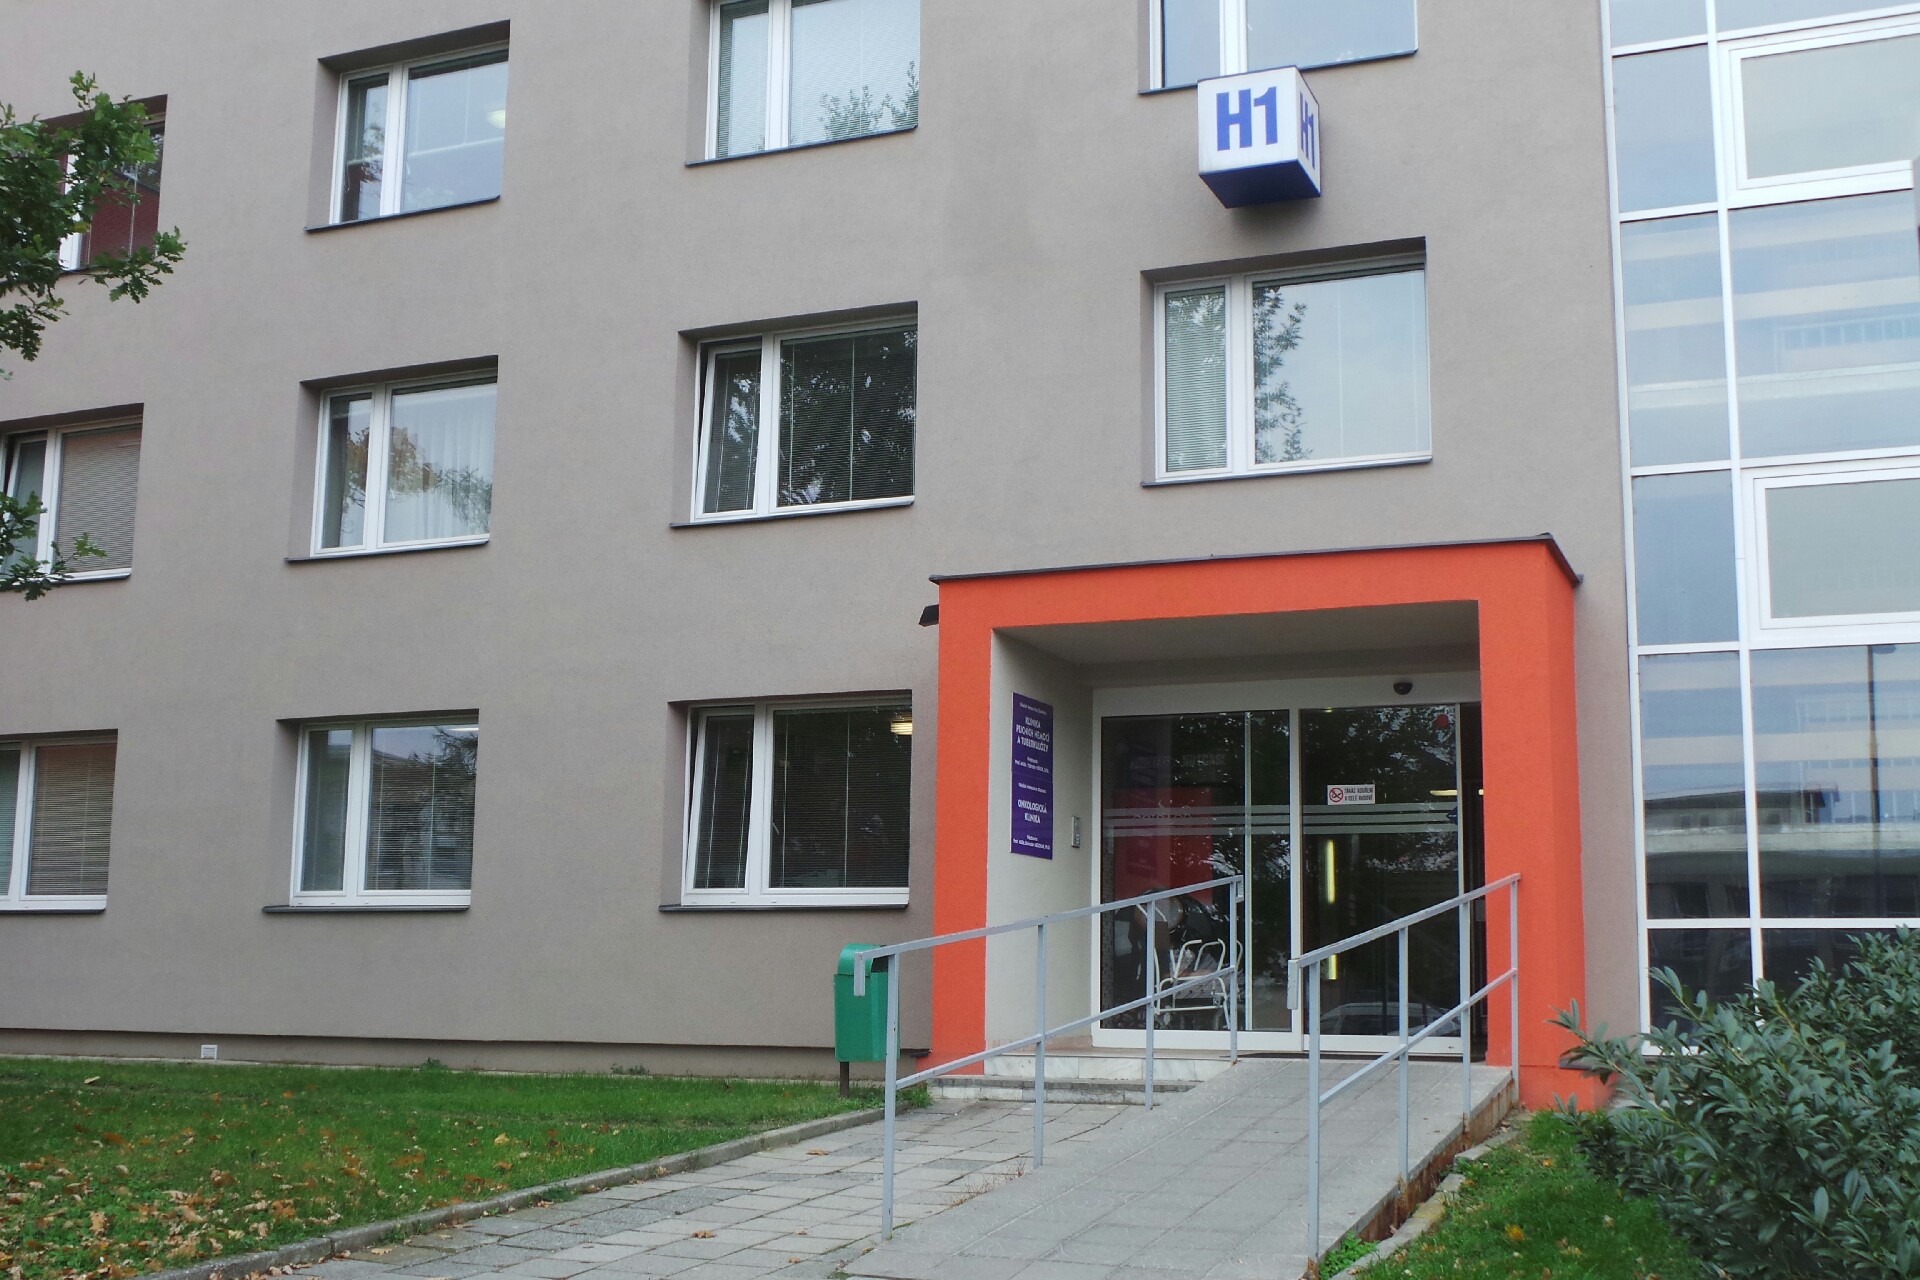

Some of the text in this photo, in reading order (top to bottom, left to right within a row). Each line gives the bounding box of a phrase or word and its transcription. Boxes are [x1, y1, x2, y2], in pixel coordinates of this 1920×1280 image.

[1216, 86, 1278, 151] H1
[1299, 91, 1315, 170] H1
[1016, 736, 1021, 745] A
[1024, 812, 1041, 824] KLINIKA
